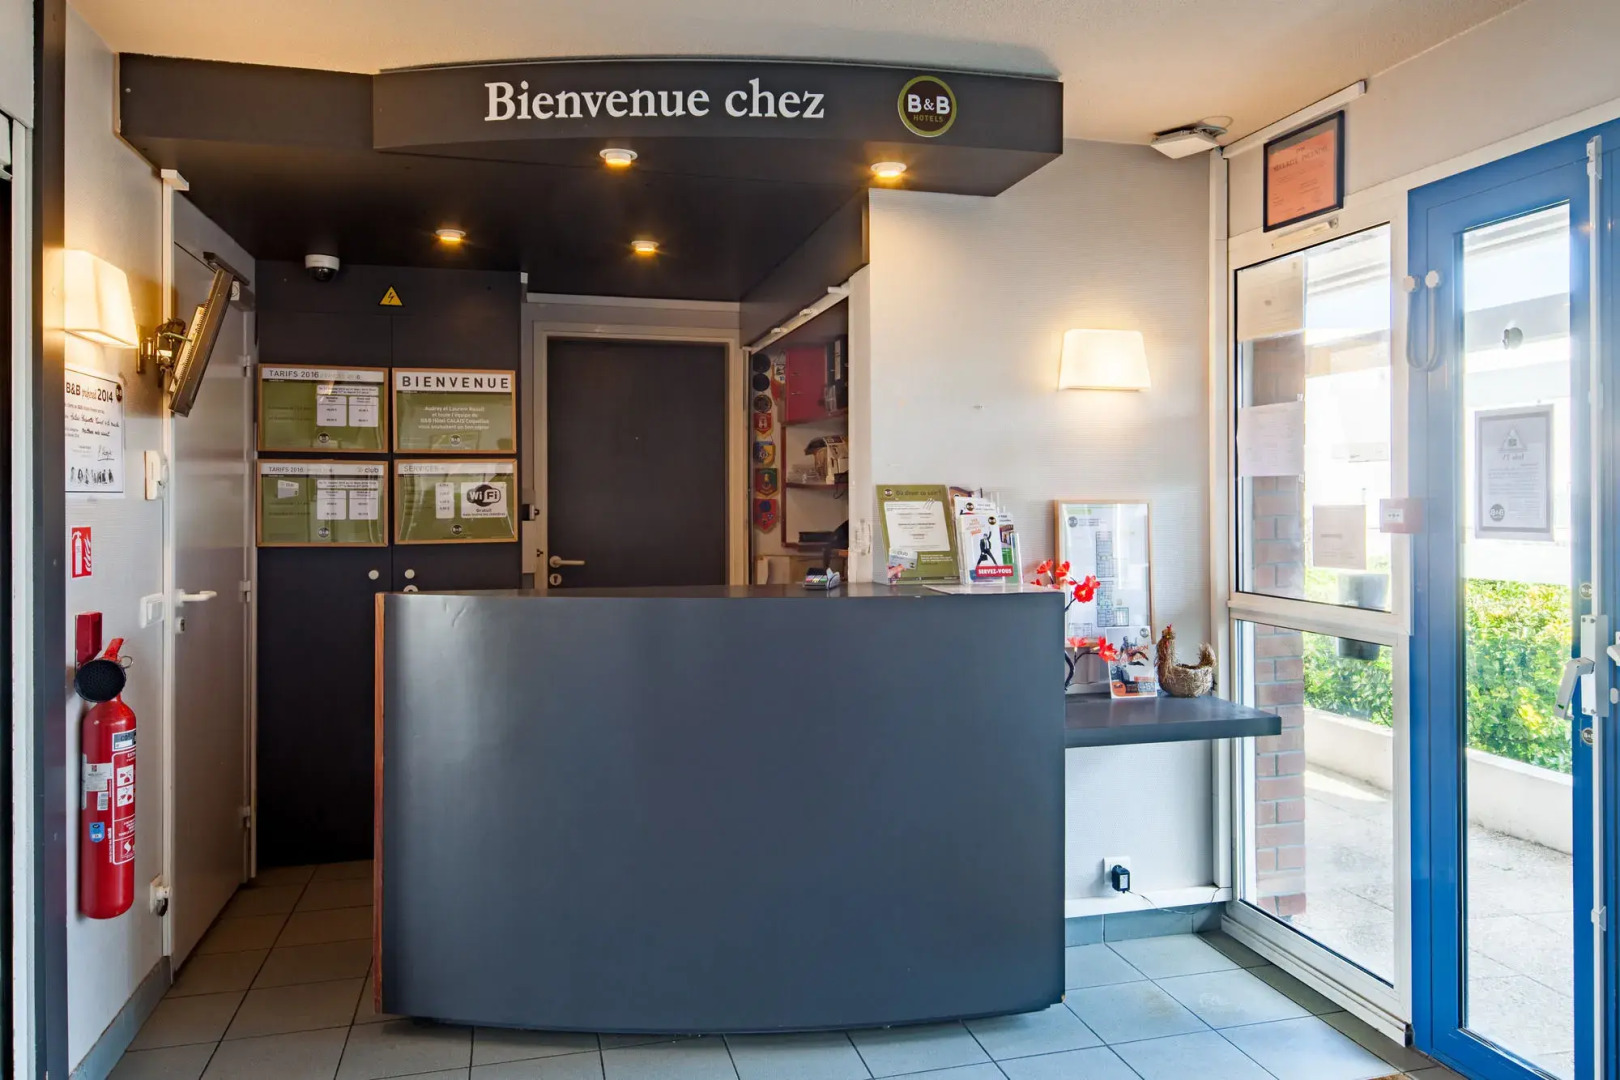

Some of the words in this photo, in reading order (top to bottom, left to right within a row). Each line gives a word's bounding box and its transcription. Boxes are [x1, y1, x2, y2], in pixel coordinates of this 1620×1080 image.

[484, 80, 710, 122] Bienvenue
[725, 78, 825, 119] chez
[908, 94, 950, 114] B&B
[269, 370, 298, 378] TARIFS
[301, 371, 319, 379] 2016
[402, 376, 509, 389] BIENVENUE
[66, 382, 81, 396] B&B
[97, 388, 113, 403] 2014
